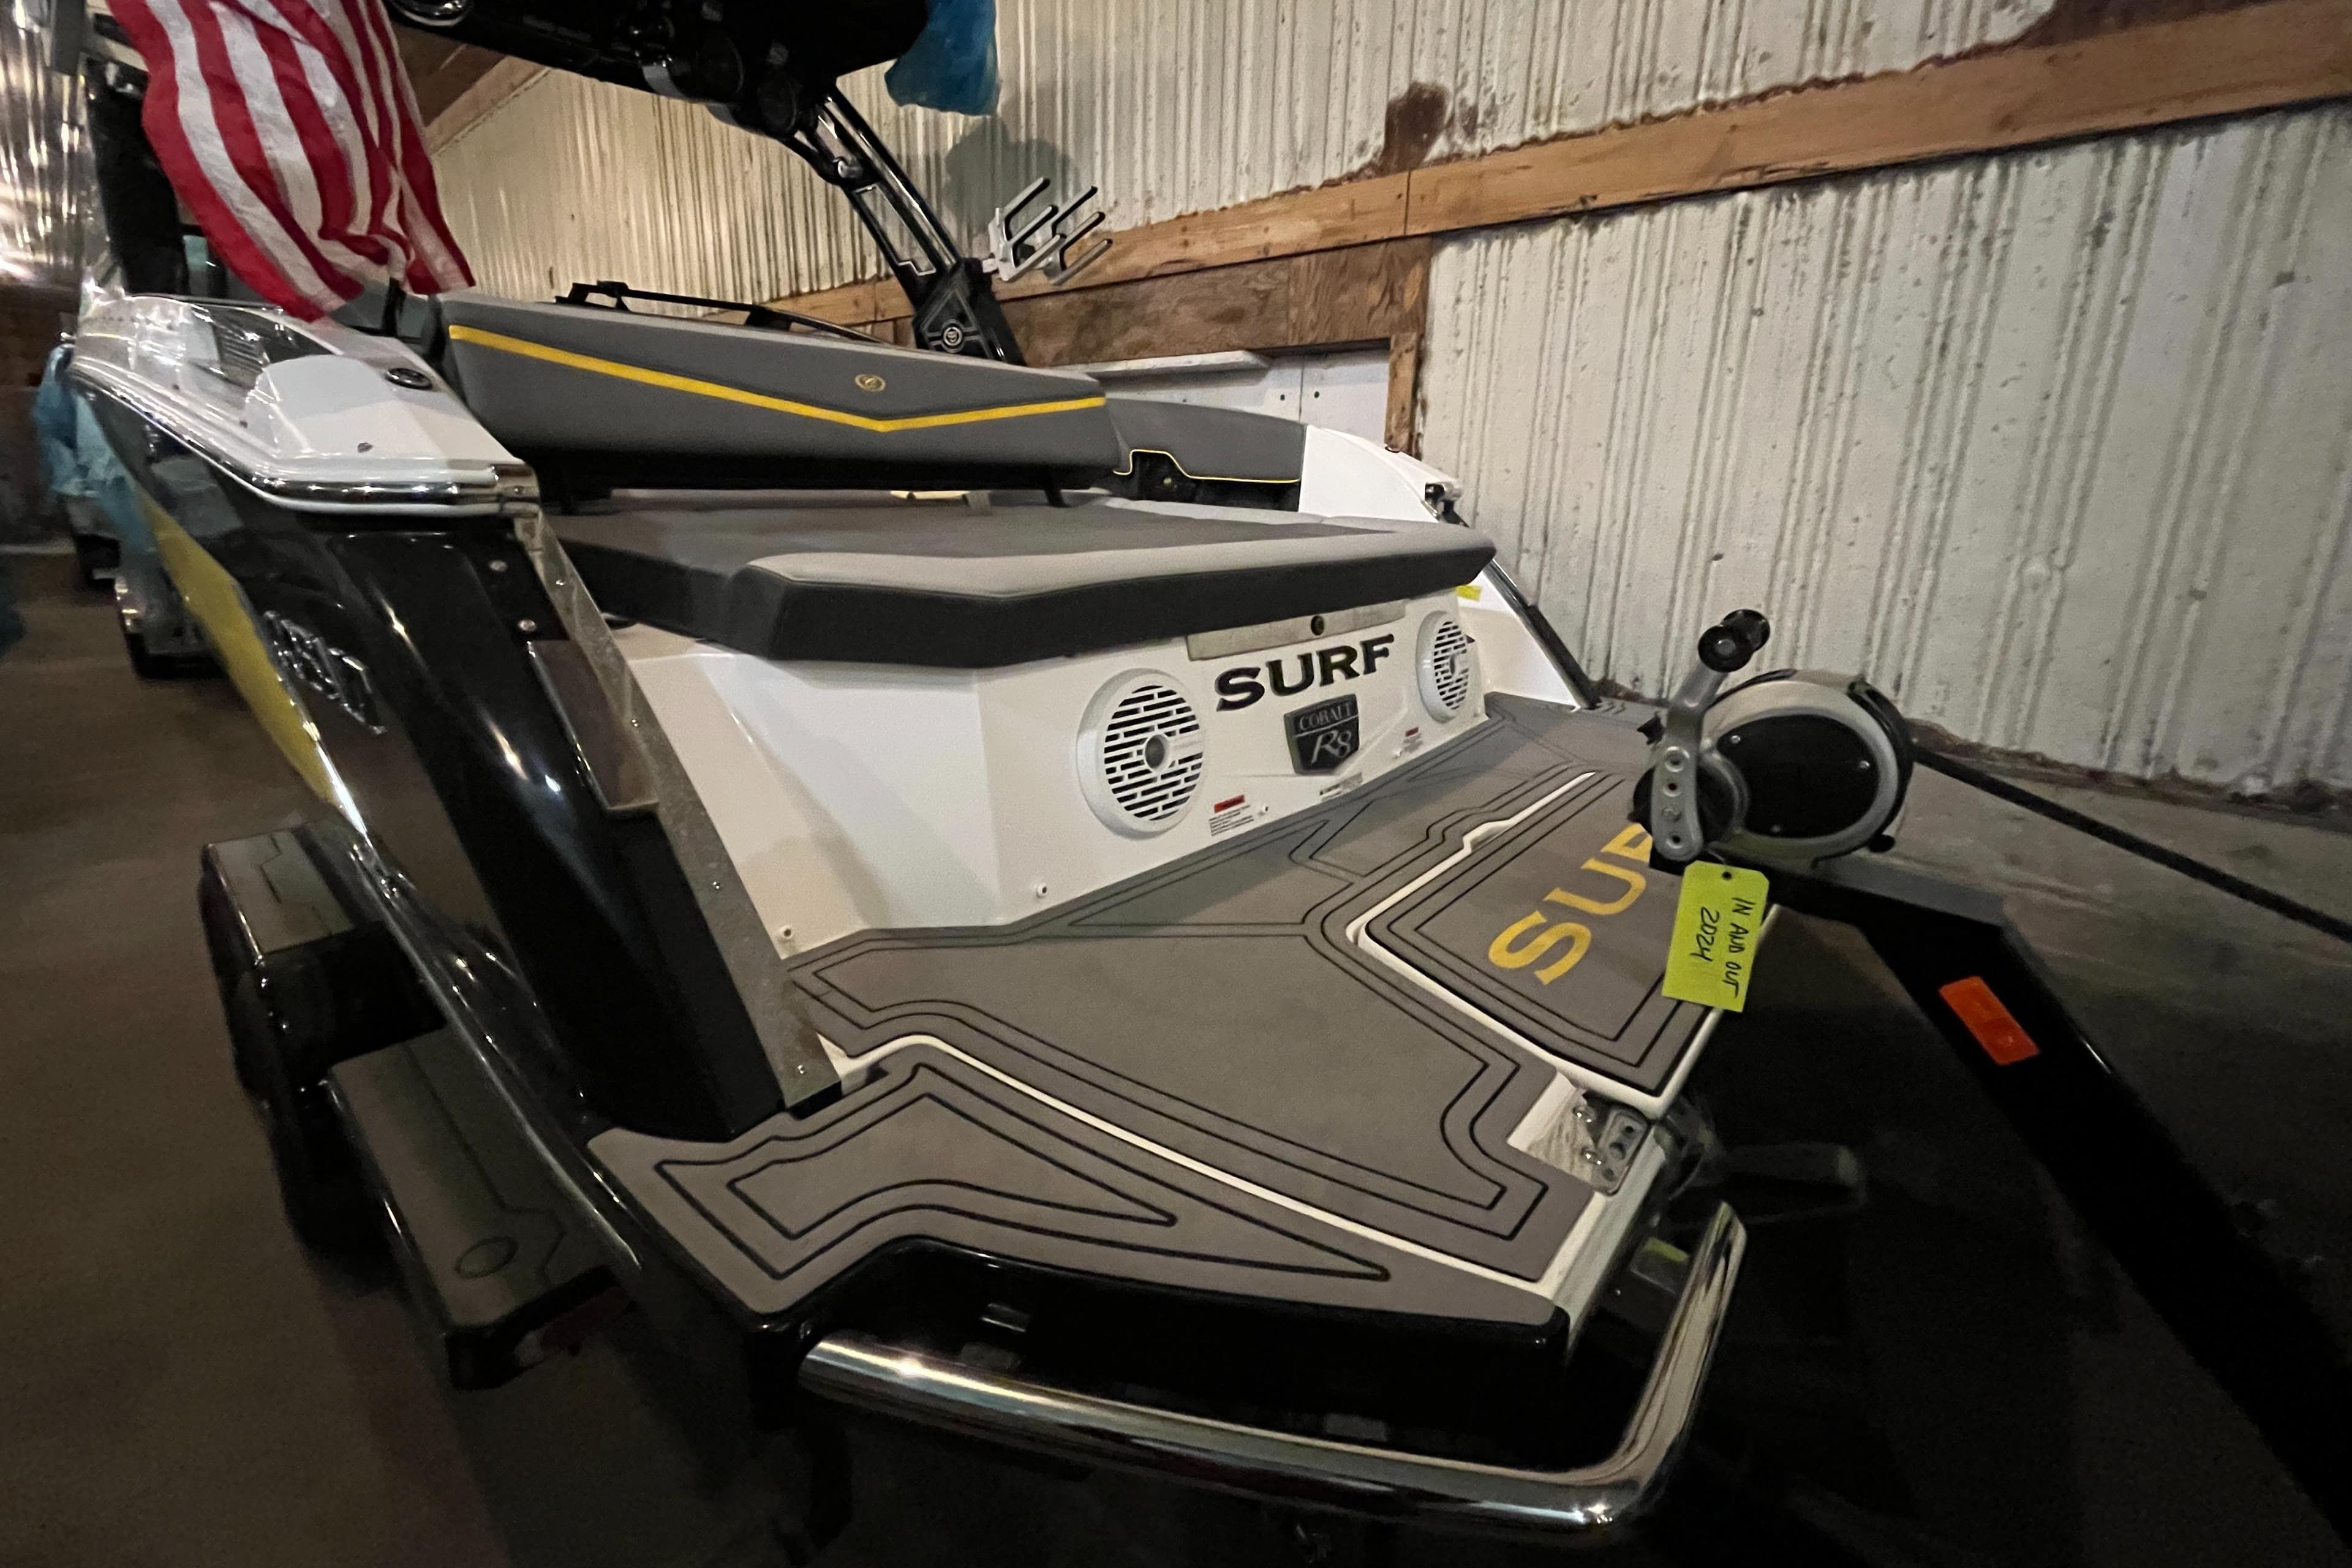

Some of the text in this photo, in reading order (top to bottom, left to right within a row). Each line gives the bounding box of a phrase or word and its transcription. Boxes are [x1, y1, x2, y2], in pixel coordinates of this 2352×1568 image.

[1215, 634, 1395, 712] SURF
[1311, 729, 1352, 764] R8
[1689, 906, 1721, 962] 2024
[1722, 897, 1757, 999] IN AND OUT
